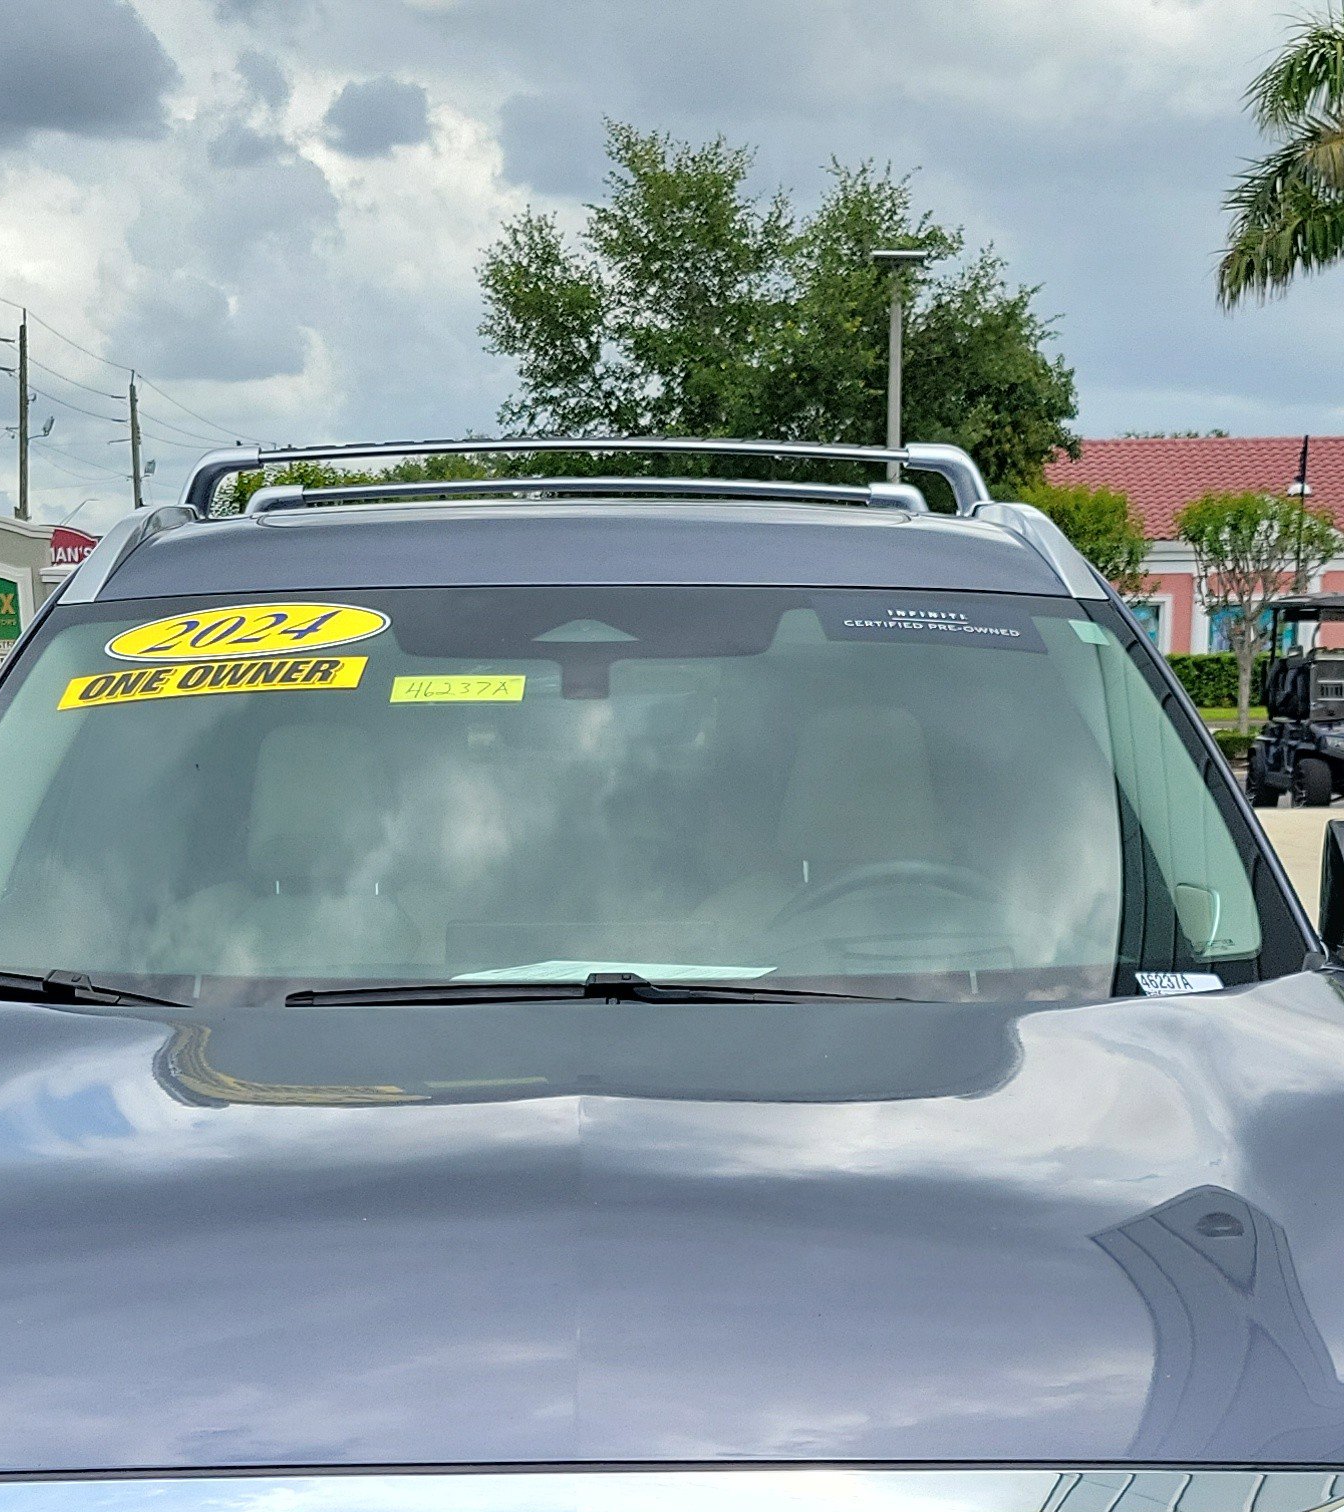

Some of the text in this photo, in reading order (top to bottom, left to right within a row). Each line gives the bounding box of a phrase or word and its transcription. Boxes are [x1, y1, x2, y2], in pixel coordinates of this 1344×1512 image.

[50, 546, 93, 562] AN'S
[887, 609, 968, 620] INFINITI
[138, 609, 343, 655] 2024
[843, 619, 1021, 637] CERTIFIED PRE-OWNED
[77, 658, 344, 702] ONE OWNER
[405, 681, 509, 699] 46237A
[1140, 974, 1194, 990] 46237A
